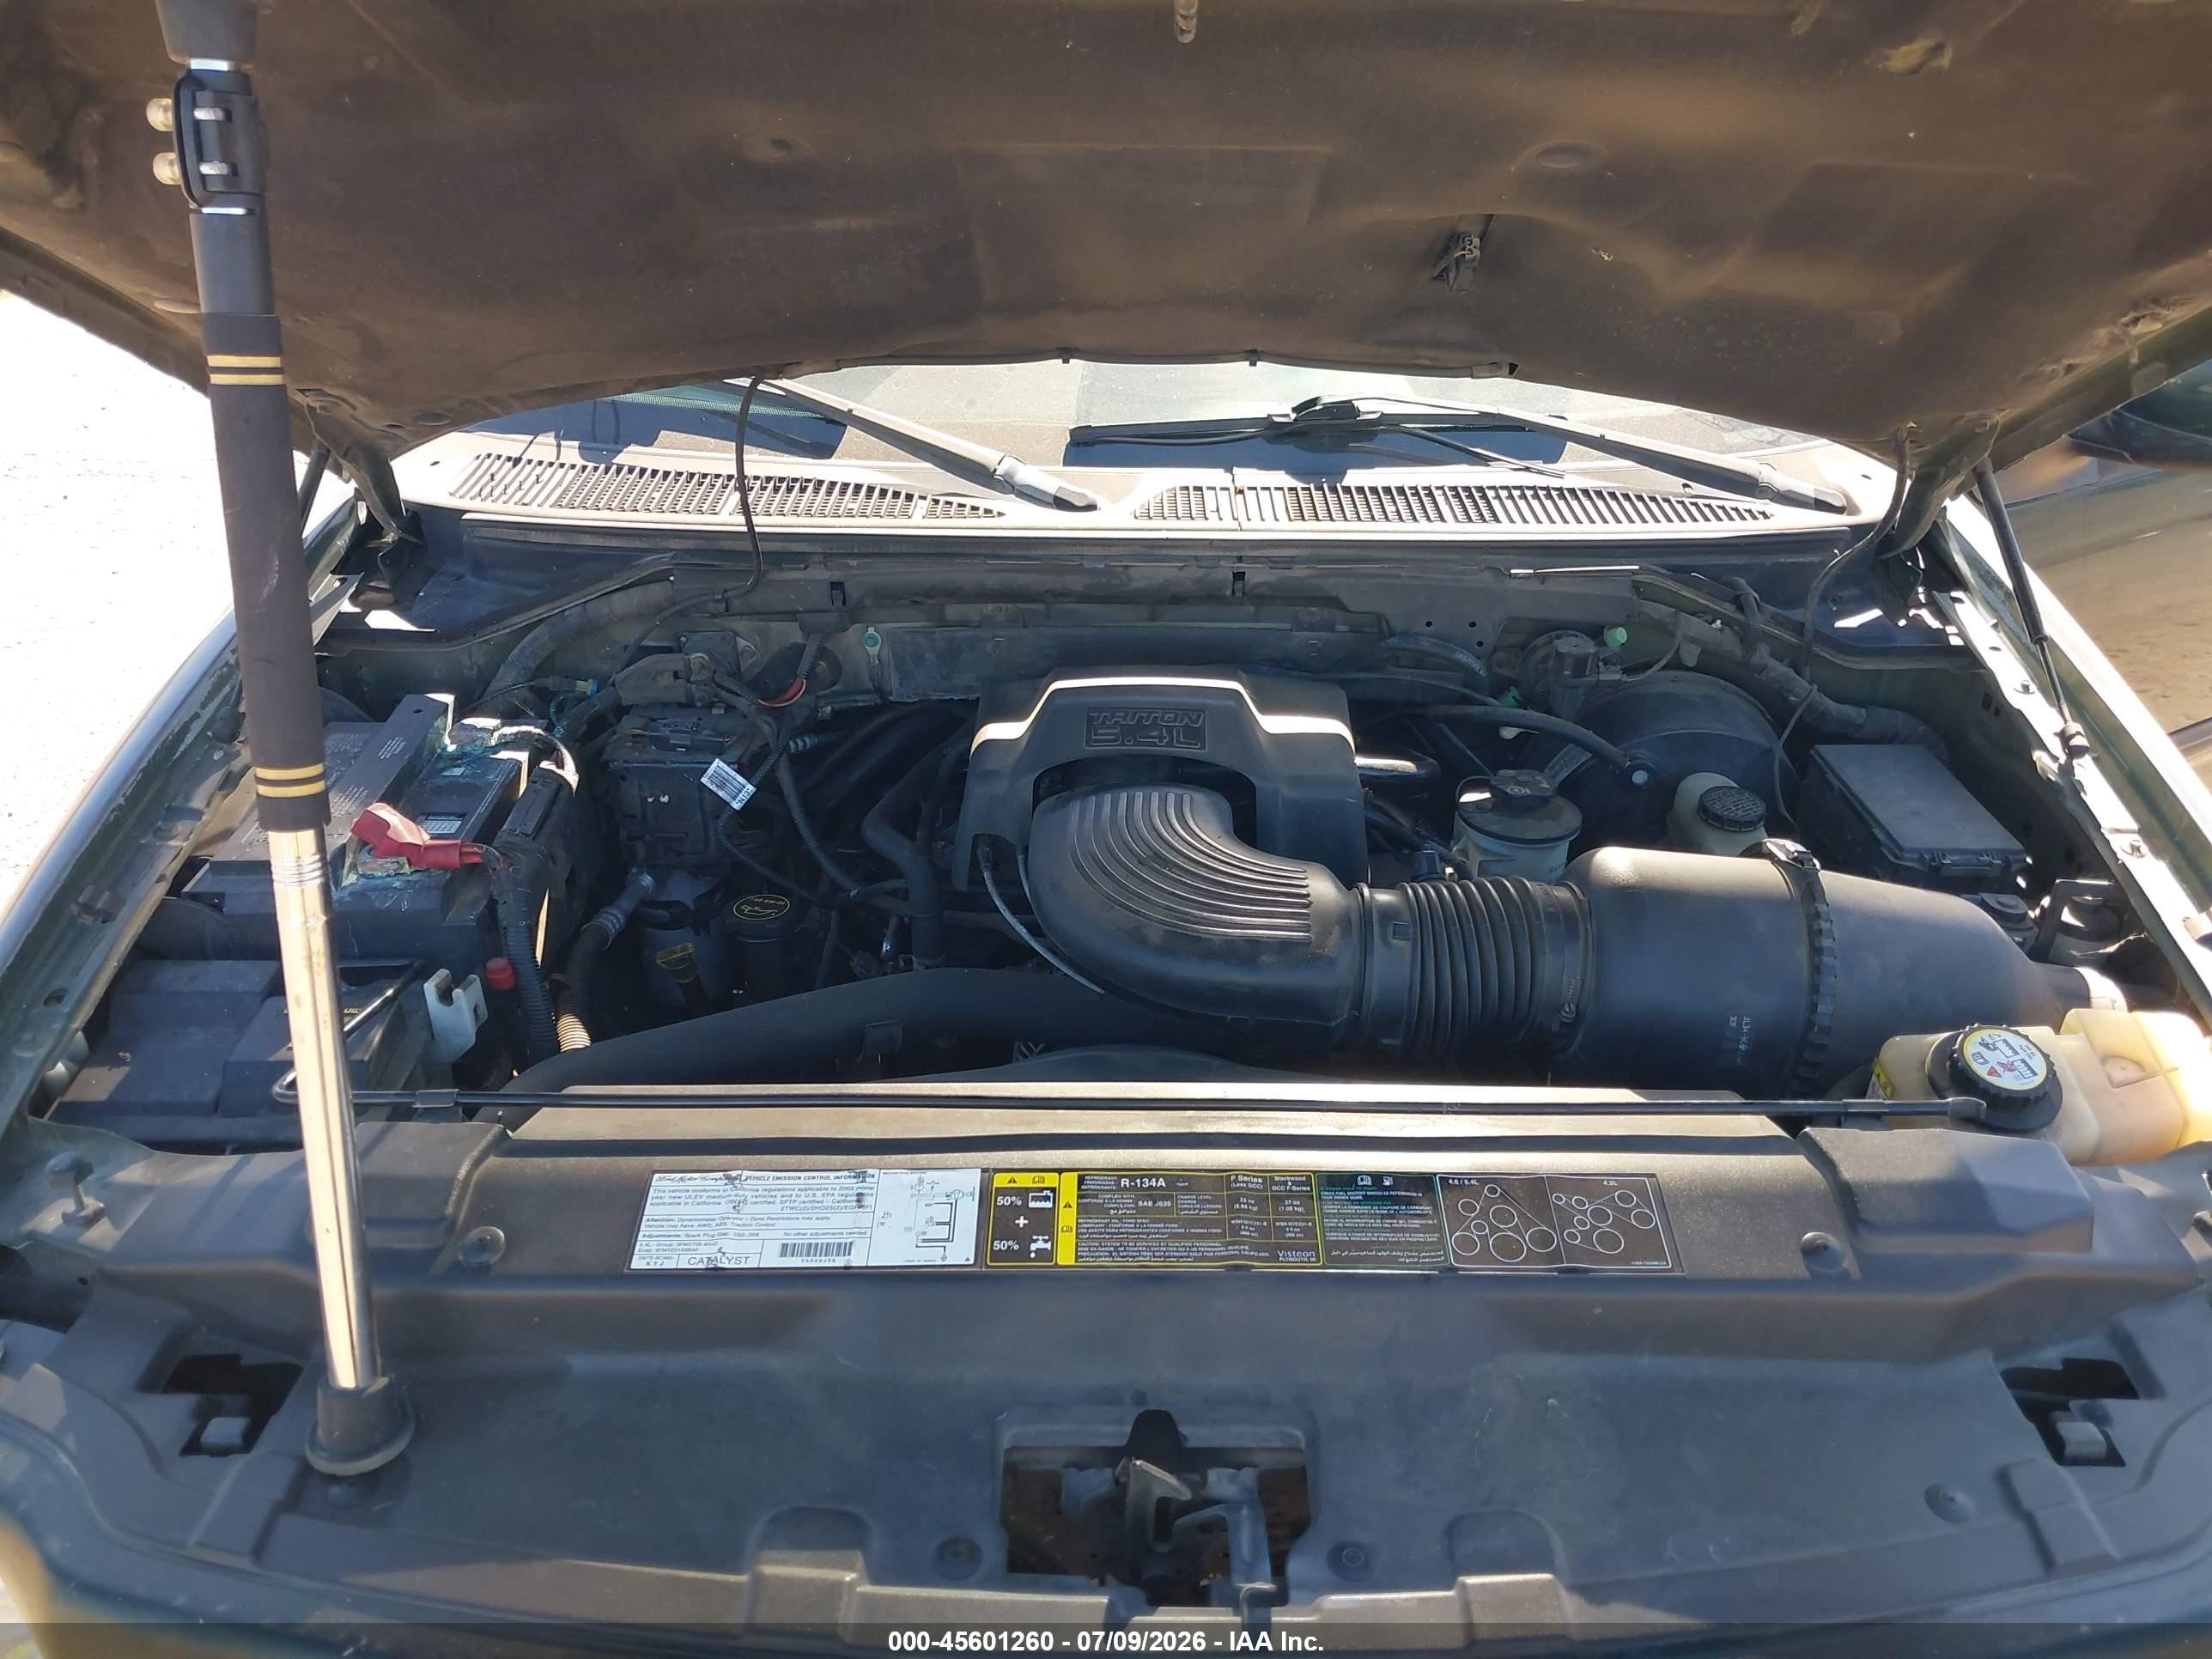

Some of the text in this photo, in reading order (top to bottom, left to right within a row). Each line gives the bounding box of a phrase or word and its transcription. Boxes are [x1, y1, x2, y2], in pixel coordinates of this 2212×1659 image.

[1088, 712, 1203, 727] TRITON
[1091, 727, 1201, 749] 5.4L
[1121, 1178, 1166, 1188] R-134A
[1238, 1175, 1262, 1183] Series
[996, 1196, 1023, 1206] 50%
[993, 1240, 1019, 1251] 50%
[687, 1255, 750, 1267] CATALYST
